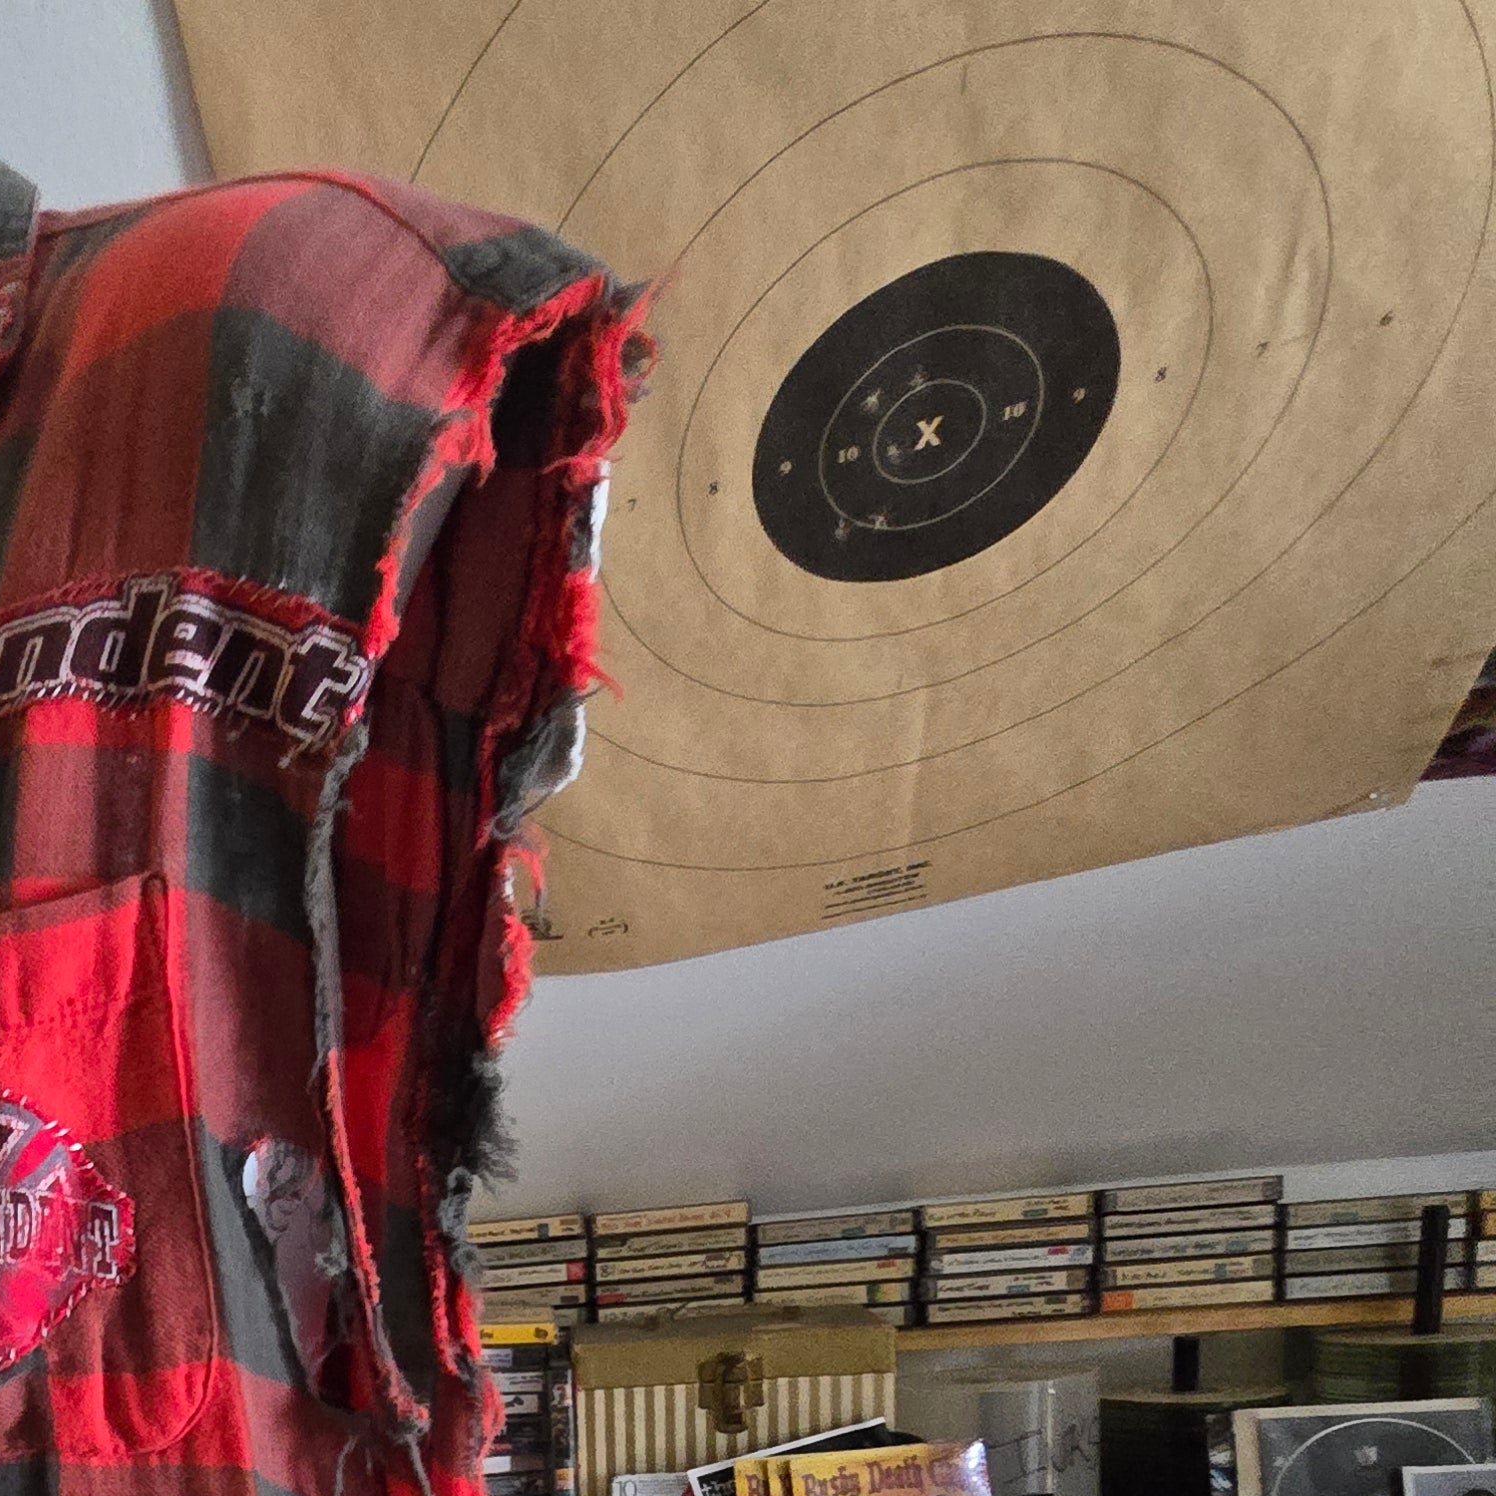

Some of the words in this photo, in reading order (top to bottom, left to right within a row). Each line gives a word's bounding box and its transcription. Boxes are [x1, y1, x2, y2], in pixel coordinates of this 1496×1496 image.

[709, 480, 721, 496] 8
[778, 460, 792, 476] 9
[837, 446, 859, 465] 10
[913, 415, 944, 451] X
[1000, 401, 1028, 422] 10
[1071, 387, 1086, 404] 9
[1155, 366, 1168, 384] 8
